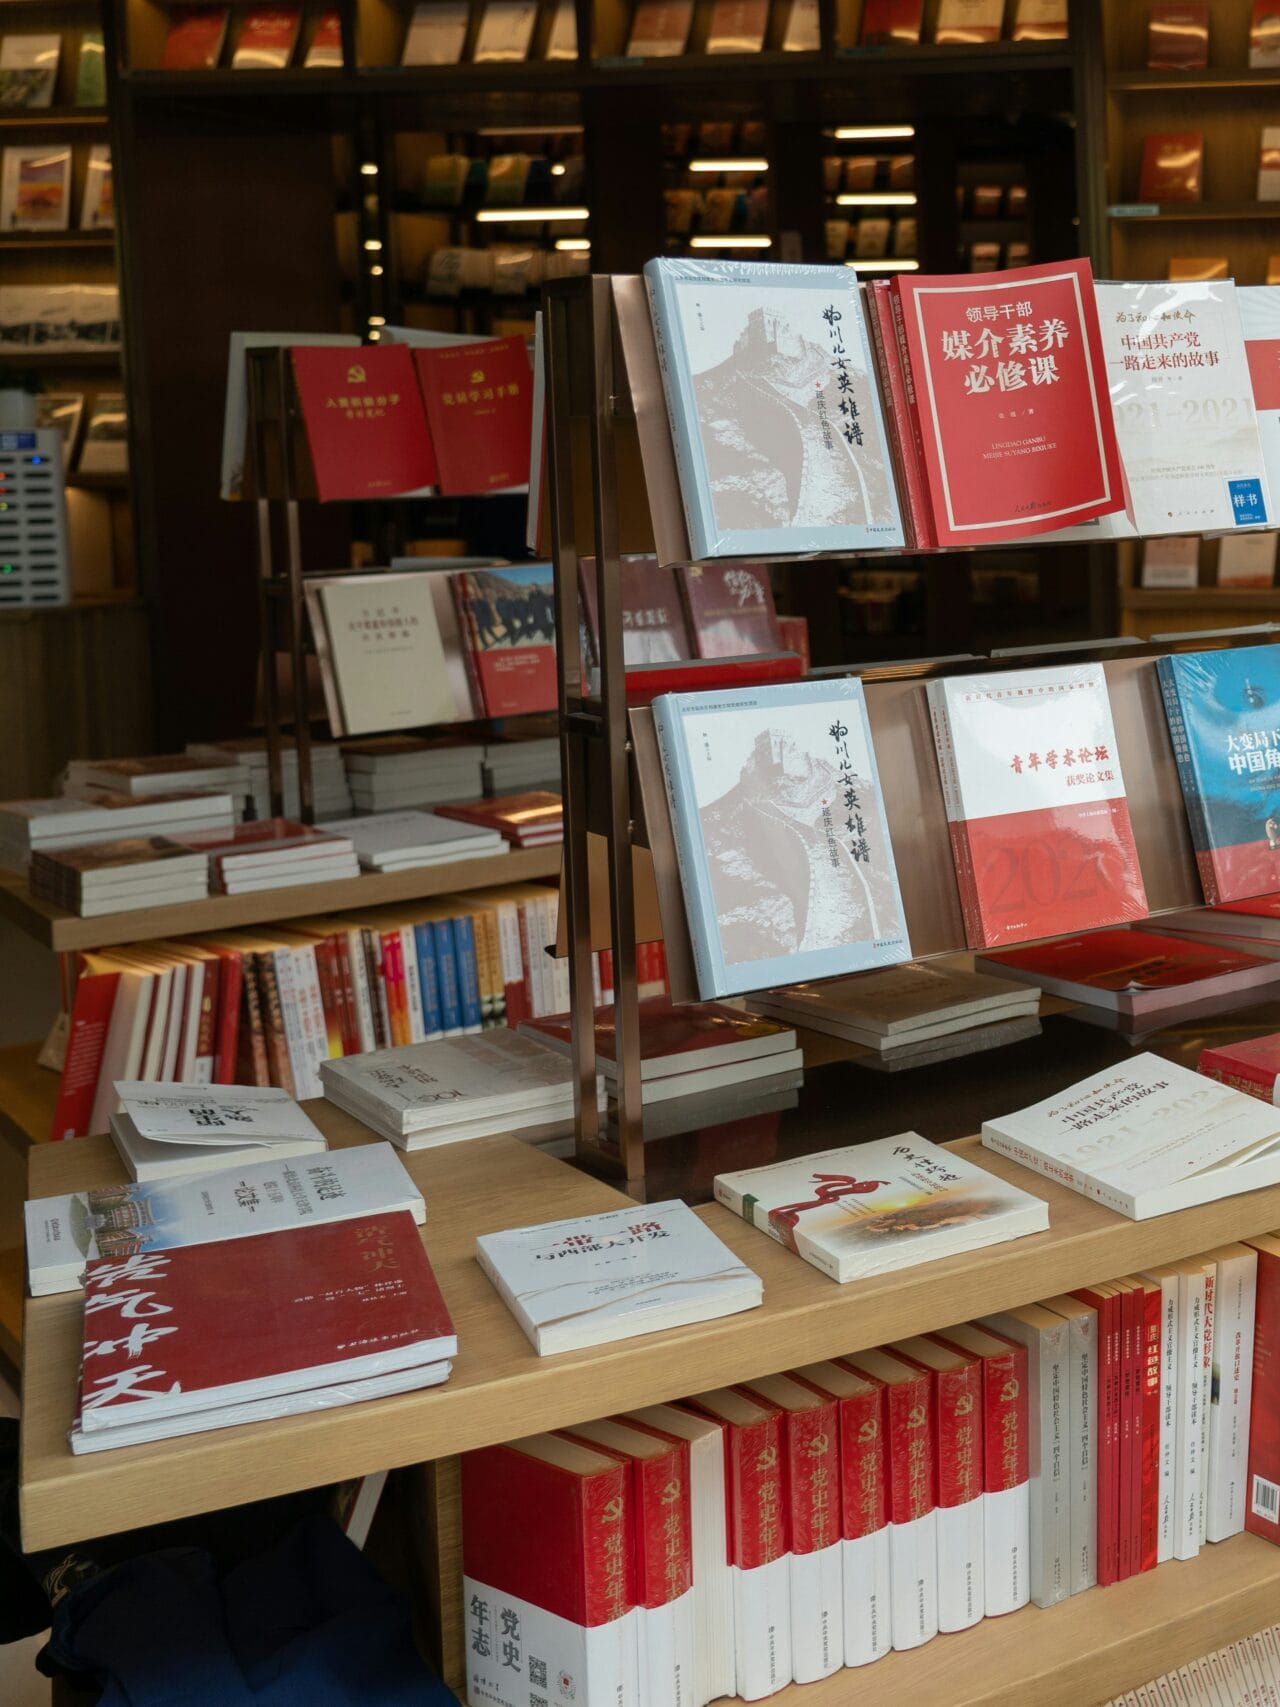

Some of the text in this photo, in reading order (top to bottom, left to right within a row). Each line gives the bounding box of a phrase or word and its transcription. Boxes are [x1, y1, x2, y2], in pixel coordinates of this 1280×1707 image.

[965, 301, 1033, 323] 领导干部
[941, 318, 1069, 361] 媒介素养
[1120, 332, 1201, 351] 中国共产党
[964, 354, 1060, 395] 必修课
[1110, 350, 1219, 371] 一路走来的故事
[1233, 494, 1258, 508] 样书
[1010, 745, 1110, 775] 青年学术论坛
[1066, 770, 1115, 787] 获奖论文集
[1202, 1276, 1215, 1368] 新时代大党形象
[470, 1593, 491, 1657] 年志
[500, 1607, 521, 1673] 党史
